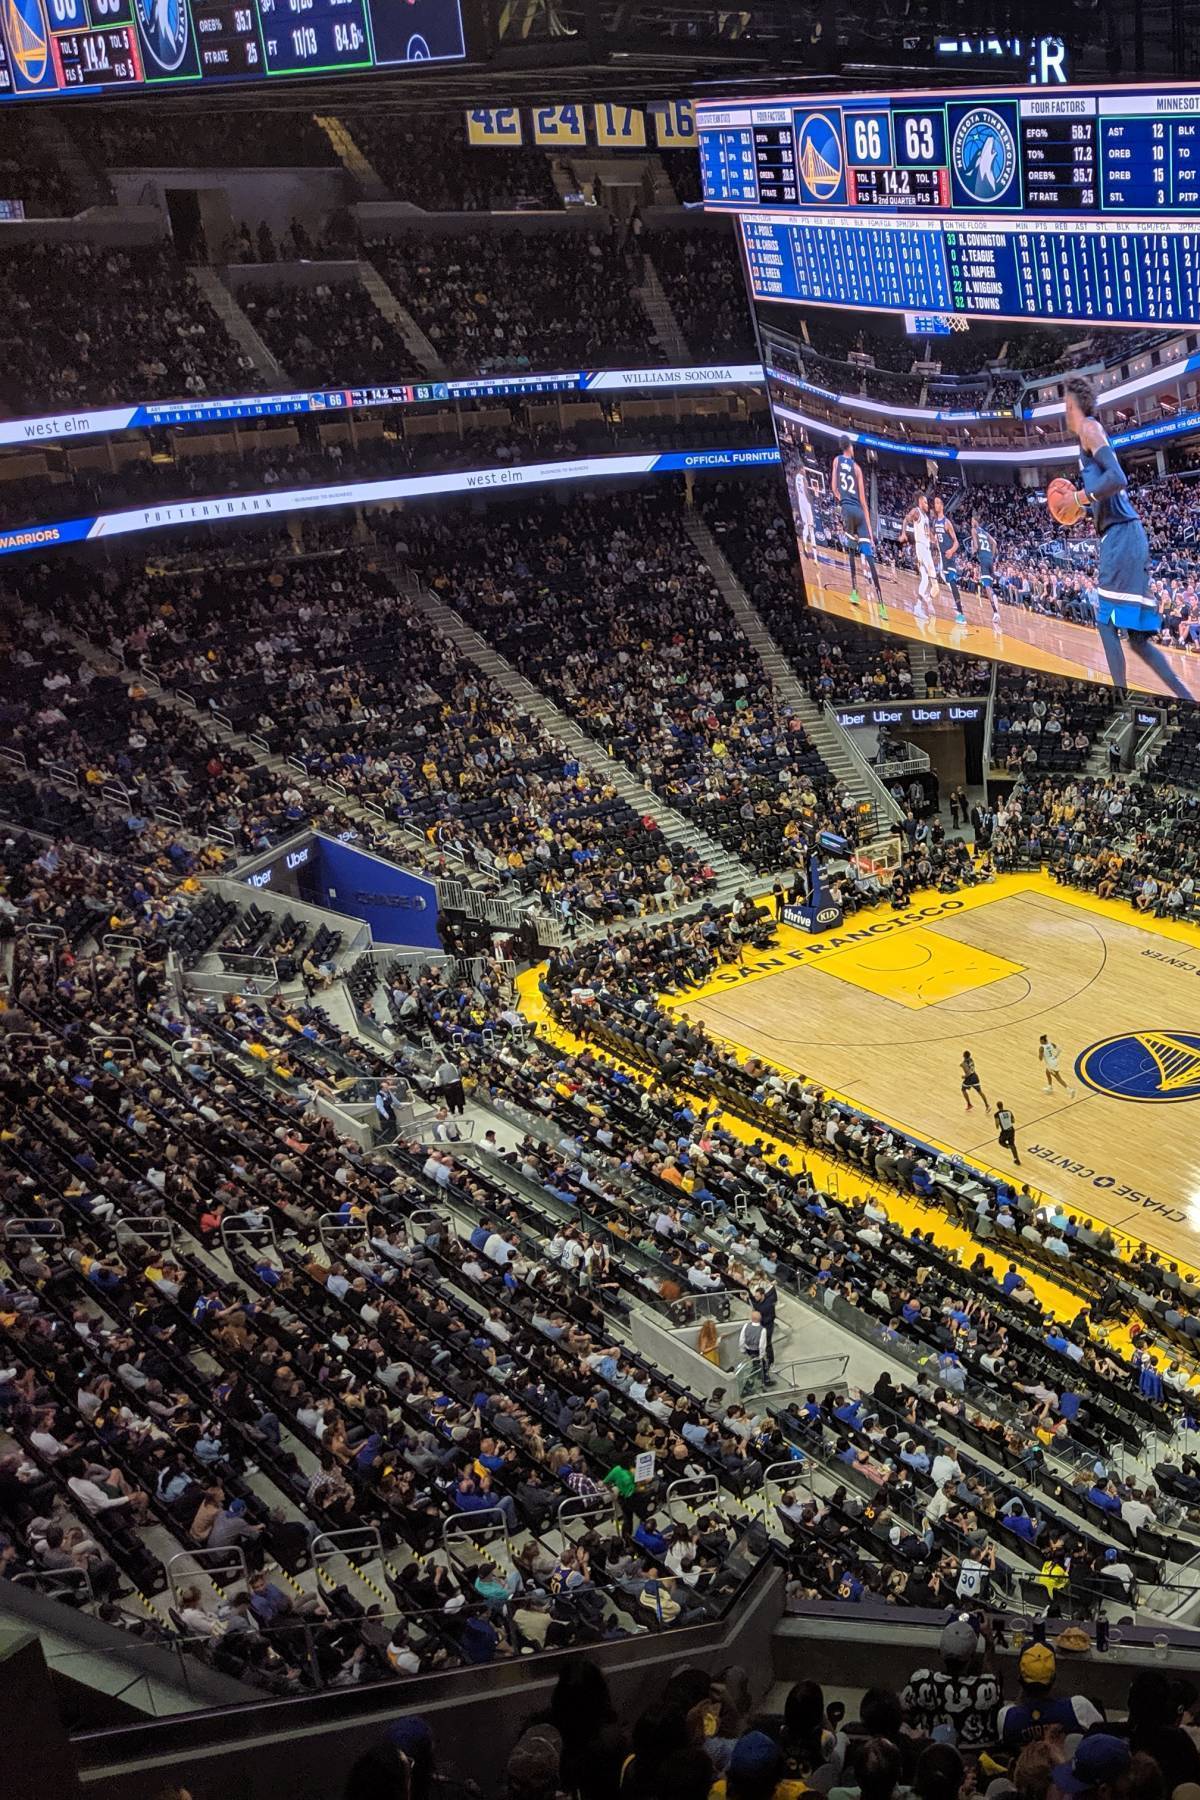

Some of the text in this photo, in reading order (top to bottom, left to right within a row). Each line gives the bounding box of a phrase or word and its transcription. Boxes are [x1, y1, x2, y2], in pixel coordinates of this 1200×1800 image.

[235, 10, 251, 32] 35.7
[267, 40, 278, 56] FT
[292, 27, 318, 59] 11/13
[247, 43, 258, 64] 25
[1031, 100, 1086, 114] FOUR FACTORS
[472, 109, 517, 134] 42
[538, 104, 580, 134] 24
[605, 104, 632, 136] 17
[664, 102, 696, 136] 16
[904, 118, 934, 160] 63
[1026, 124, 1092, 141] EFG% 58.7
[1108, 127, 1124, 137] AST
[1152, 123, 1164, 138] 12
[1178, 126, 1195, 136] BLK
[854, 119, 880, 160] 66
[1027, 146, 1093, 161] TO% 17.2
[1108, 148, 1131, 159] OREB
[1152, 145, 1165, 161] 10
[1178, 148, 1191, 158] TO
[857, 171, 938, 195] TOL 5 14.2 TOL 5
[1028, 167, 1094, 183] OREB% 35.7
[1108, 170, 1131, 181] DREB
[1152, 167, 1165, 183] 15
[1178, 170, 1196, 180] POT
[858, 192, 869, 203] FLS
[872, 191, 878, 204] 5
[889, 196, 916, 206] QUARTER
[917, 193, 930, 203] FLS
[933, 191, 939, 204] 5
[1029, 189, 1094, 204] FT RATE 25
[1109, 191, 1125, 202] STL
[1157, 190, 1165, 204] 3
[1179, 191, 1198, 202] PITP
[622, 370, 733, 384] WILLIAMS SONOMA
[329, 394, 343, 407] 66
[417, 387, 430, 399] 63
[24, 417, 91, 438] west elm
[685, 454, 731, 466] OFFICIAL
[466, 470, 523, 487] west elm
[839, 473, 856, 493] 32
[873, 709, 903, 723] Uber
[911, 709, 941, 722] Uber
[949, 707, 979, 720] Uber
[1138, 713, 1157, 724] Uber
[287, 849, 309, 868] Uber
[784, 908, 812, 927] thrive
[820, 910, 836, 921] KIA
[717, 900, 966, 985] SAN FRANCISCO
[1140, 948, 1196, 973] CENTER
[1027, 1143, 1188, 1224] CHASE CENTER
